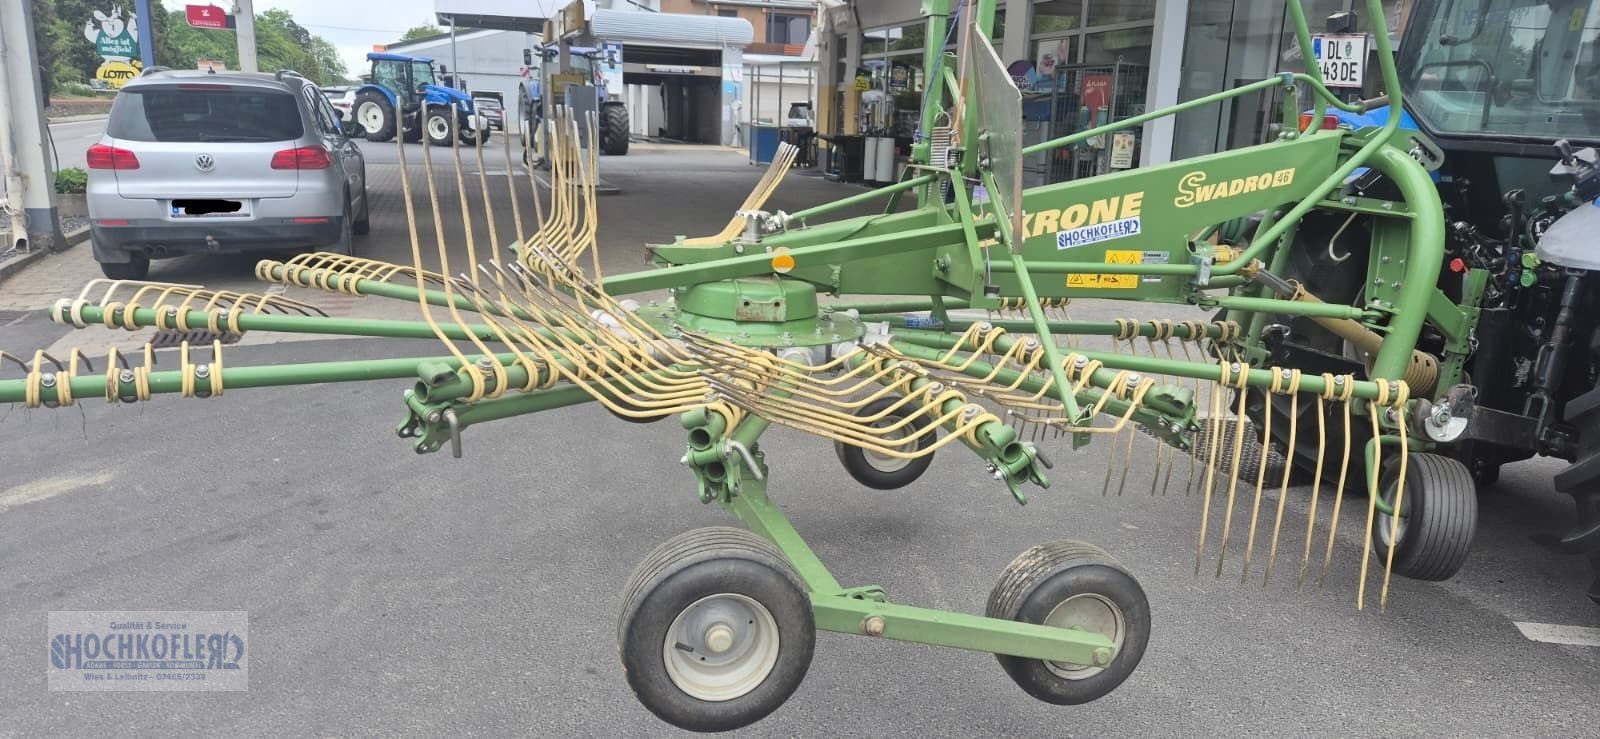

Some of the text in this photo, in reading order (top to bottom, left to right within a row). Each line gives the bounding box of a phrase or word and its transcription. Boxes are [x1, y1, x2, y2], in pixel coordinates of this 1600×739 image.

[1328, 40, 1342, 60] DL
[103, 70, 135, 80] LOTTO
[1319, 61, 1358, 81] 43 DE
